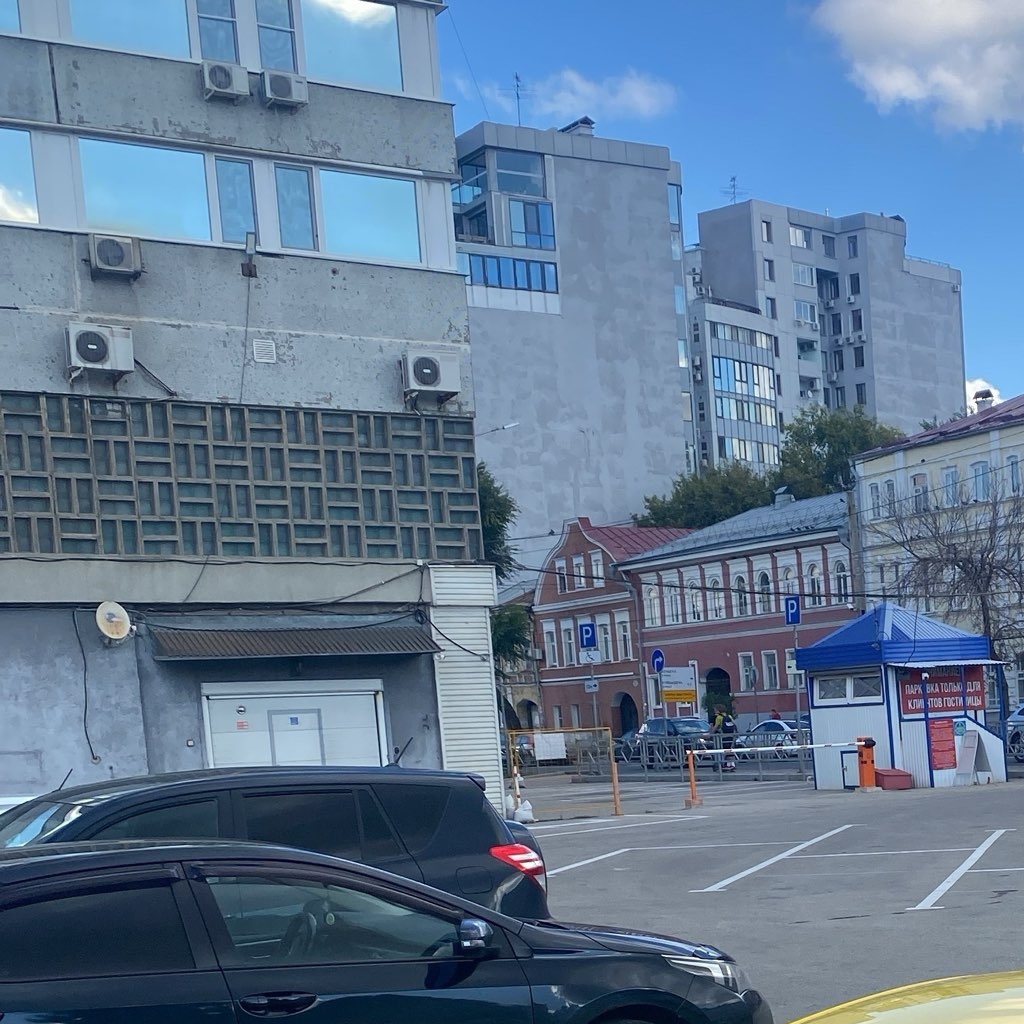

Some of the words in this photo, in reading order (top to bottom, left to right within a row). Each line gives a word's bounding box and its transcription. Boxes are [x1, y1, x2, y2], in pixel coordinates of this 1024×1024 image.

[788, 599, 797, 623] P
[583, 626, 592, 646] P
[905, 683, 940, 694] ПАРКВКА
[940, 682, 964, 693] ТОЛЬК
[966, 681, 981, 692] ДЛЯ
[943, 696, 982, 708] ГОСТИИЦЫ
